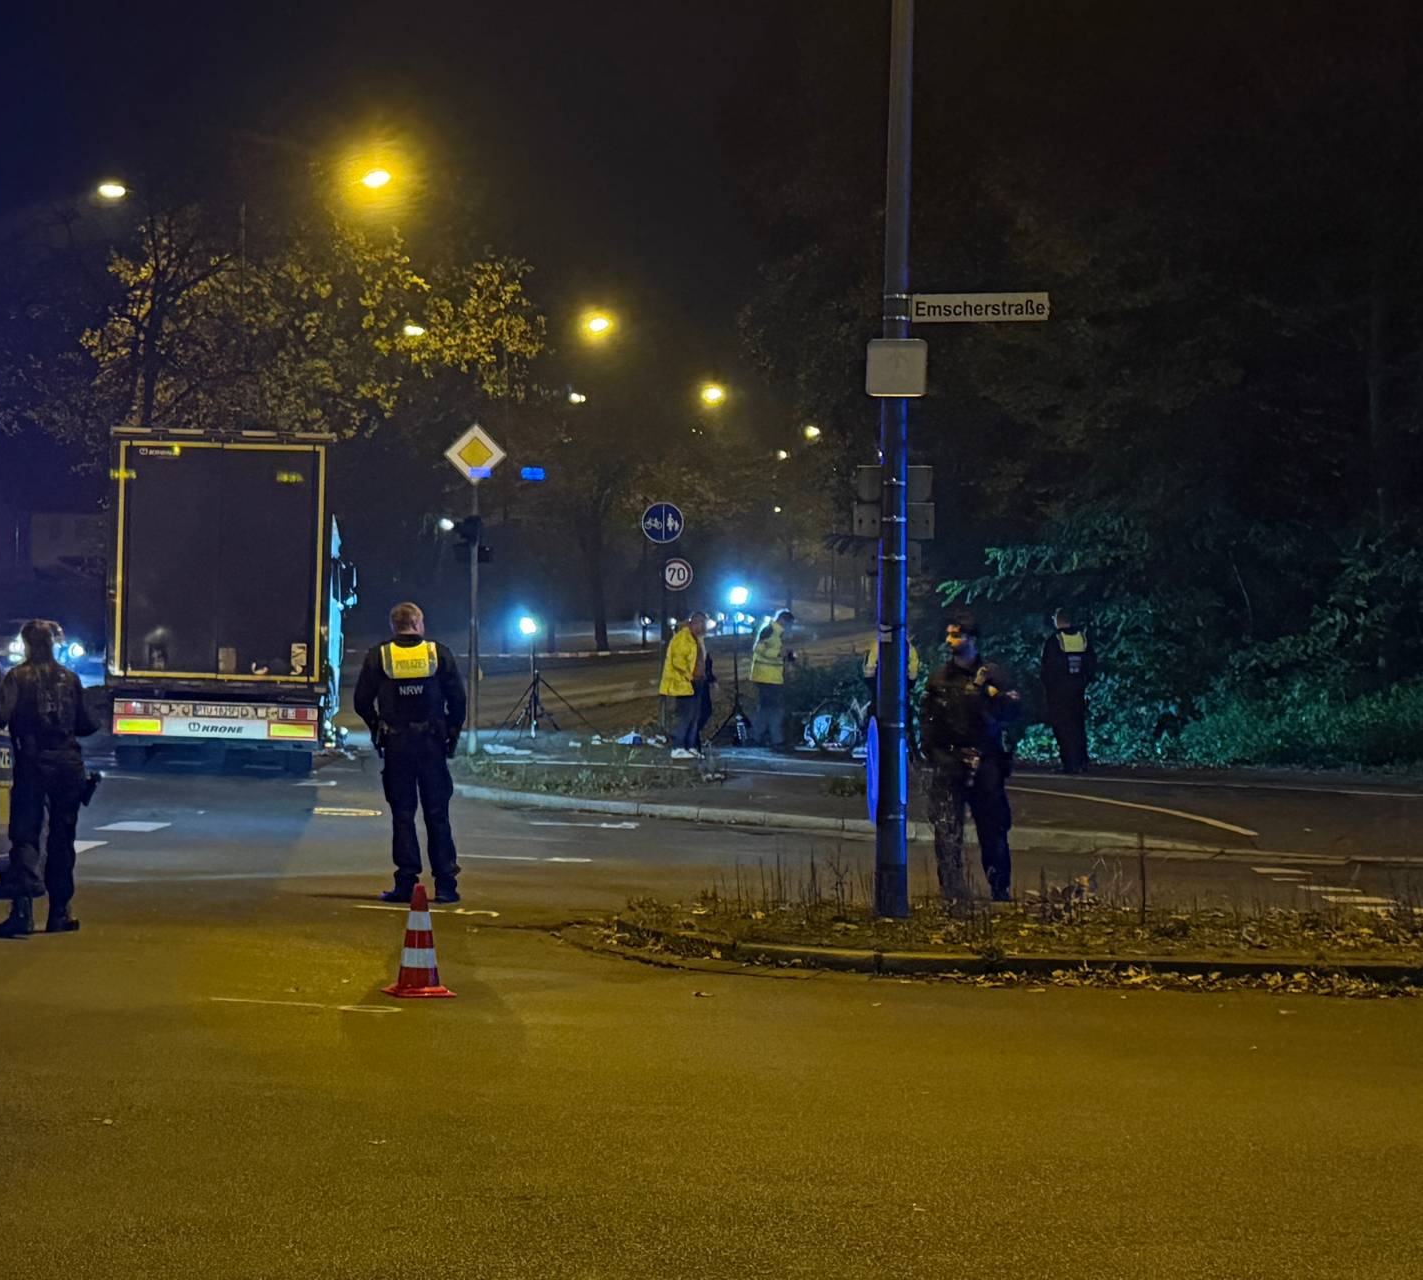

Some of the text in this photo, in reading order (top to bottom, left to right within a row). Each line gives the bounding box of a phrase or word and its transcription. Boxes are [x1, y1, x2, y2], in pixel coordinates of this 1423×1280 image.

[915, 300, 1046, 317] Emscherstraße
[668, 568, 685, 581] 70
[399, 685, 424, 696] NRW
[202, 725, 244, 734] KRONE
